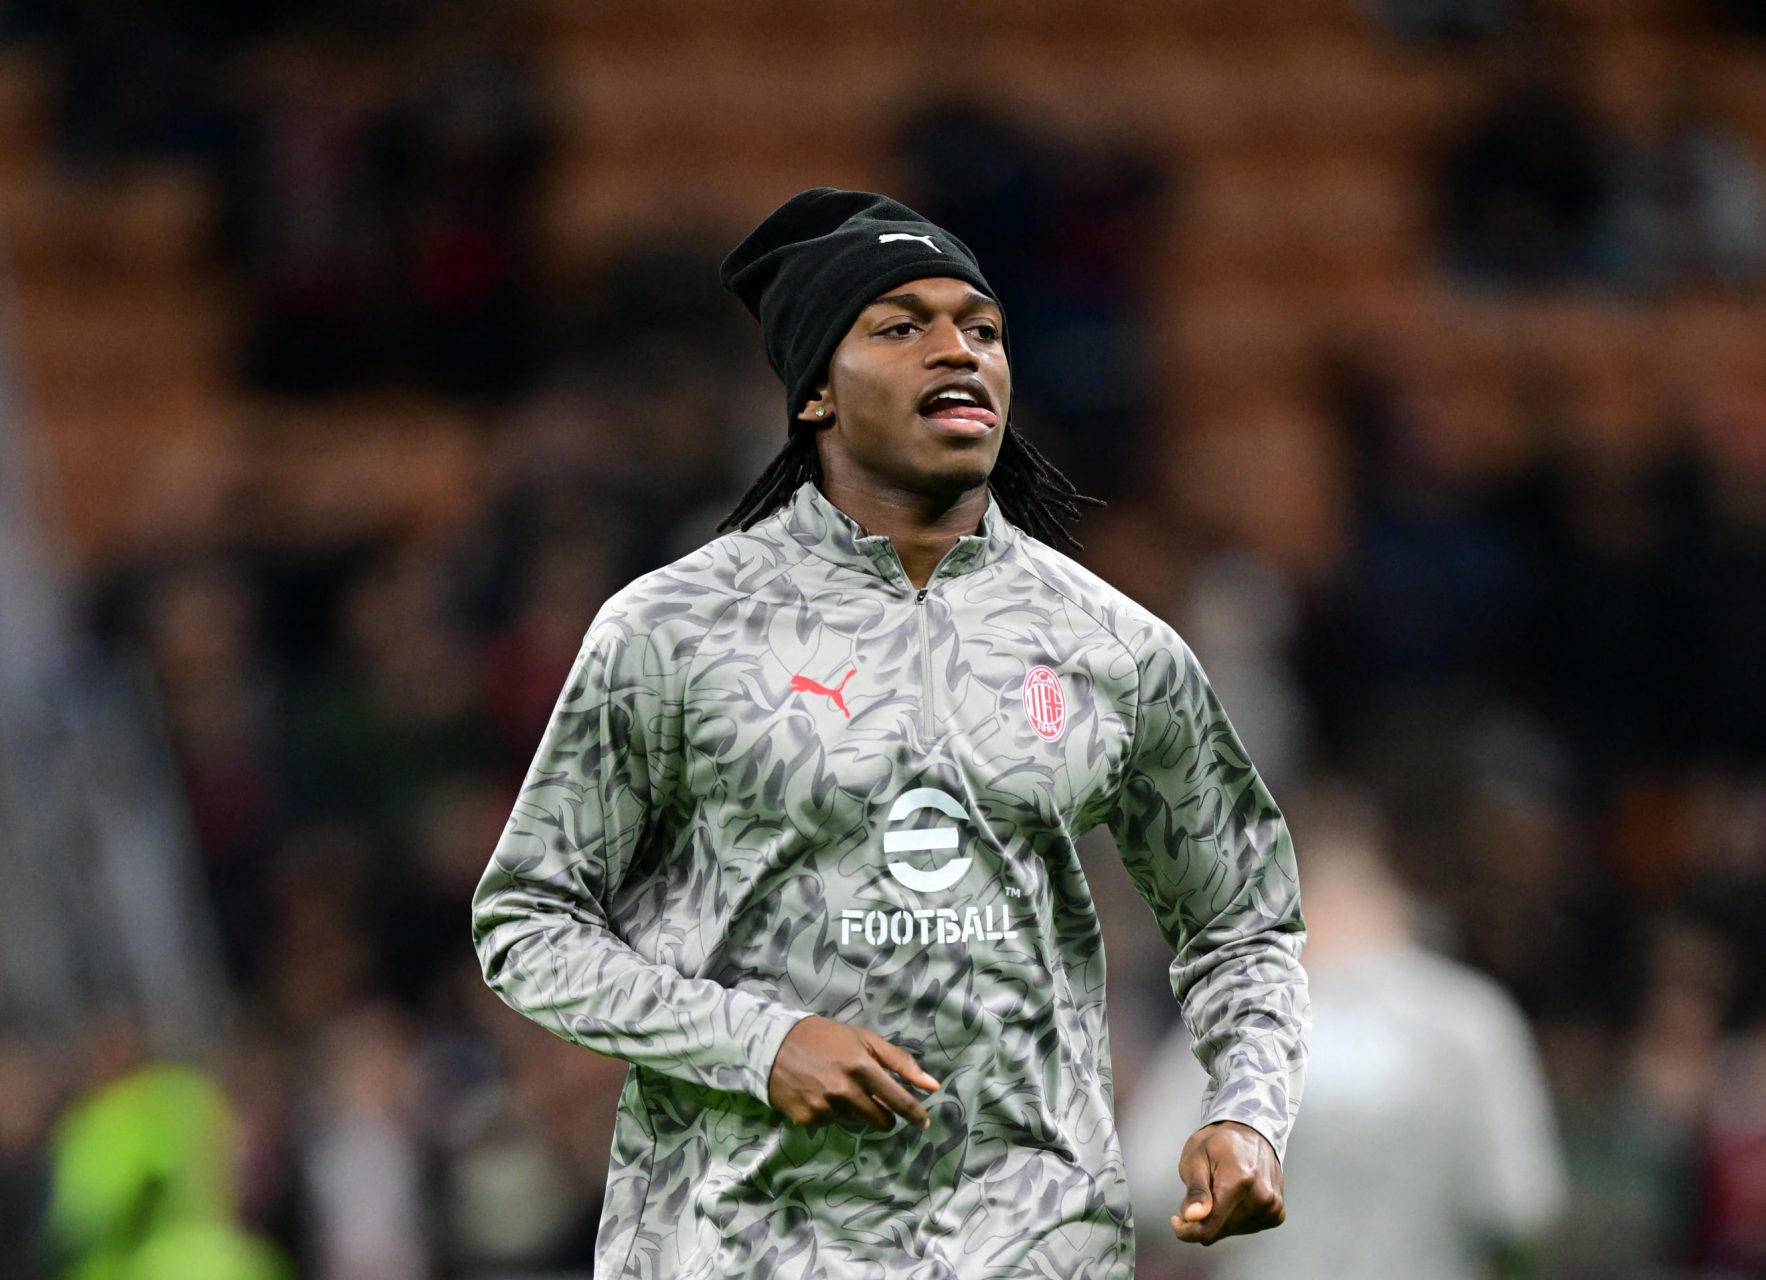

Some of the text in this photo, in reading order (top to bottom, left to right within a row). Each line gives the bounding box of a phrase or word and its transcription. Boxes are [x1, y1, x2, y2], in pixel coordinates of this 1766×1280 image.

[1031, 672, 1056, 688] ACM
[1036, 723, 1058, 733] 1899
[1004, 886, 1021, 898] TM
[841, 904, 1018, 945] FOOTBALL
